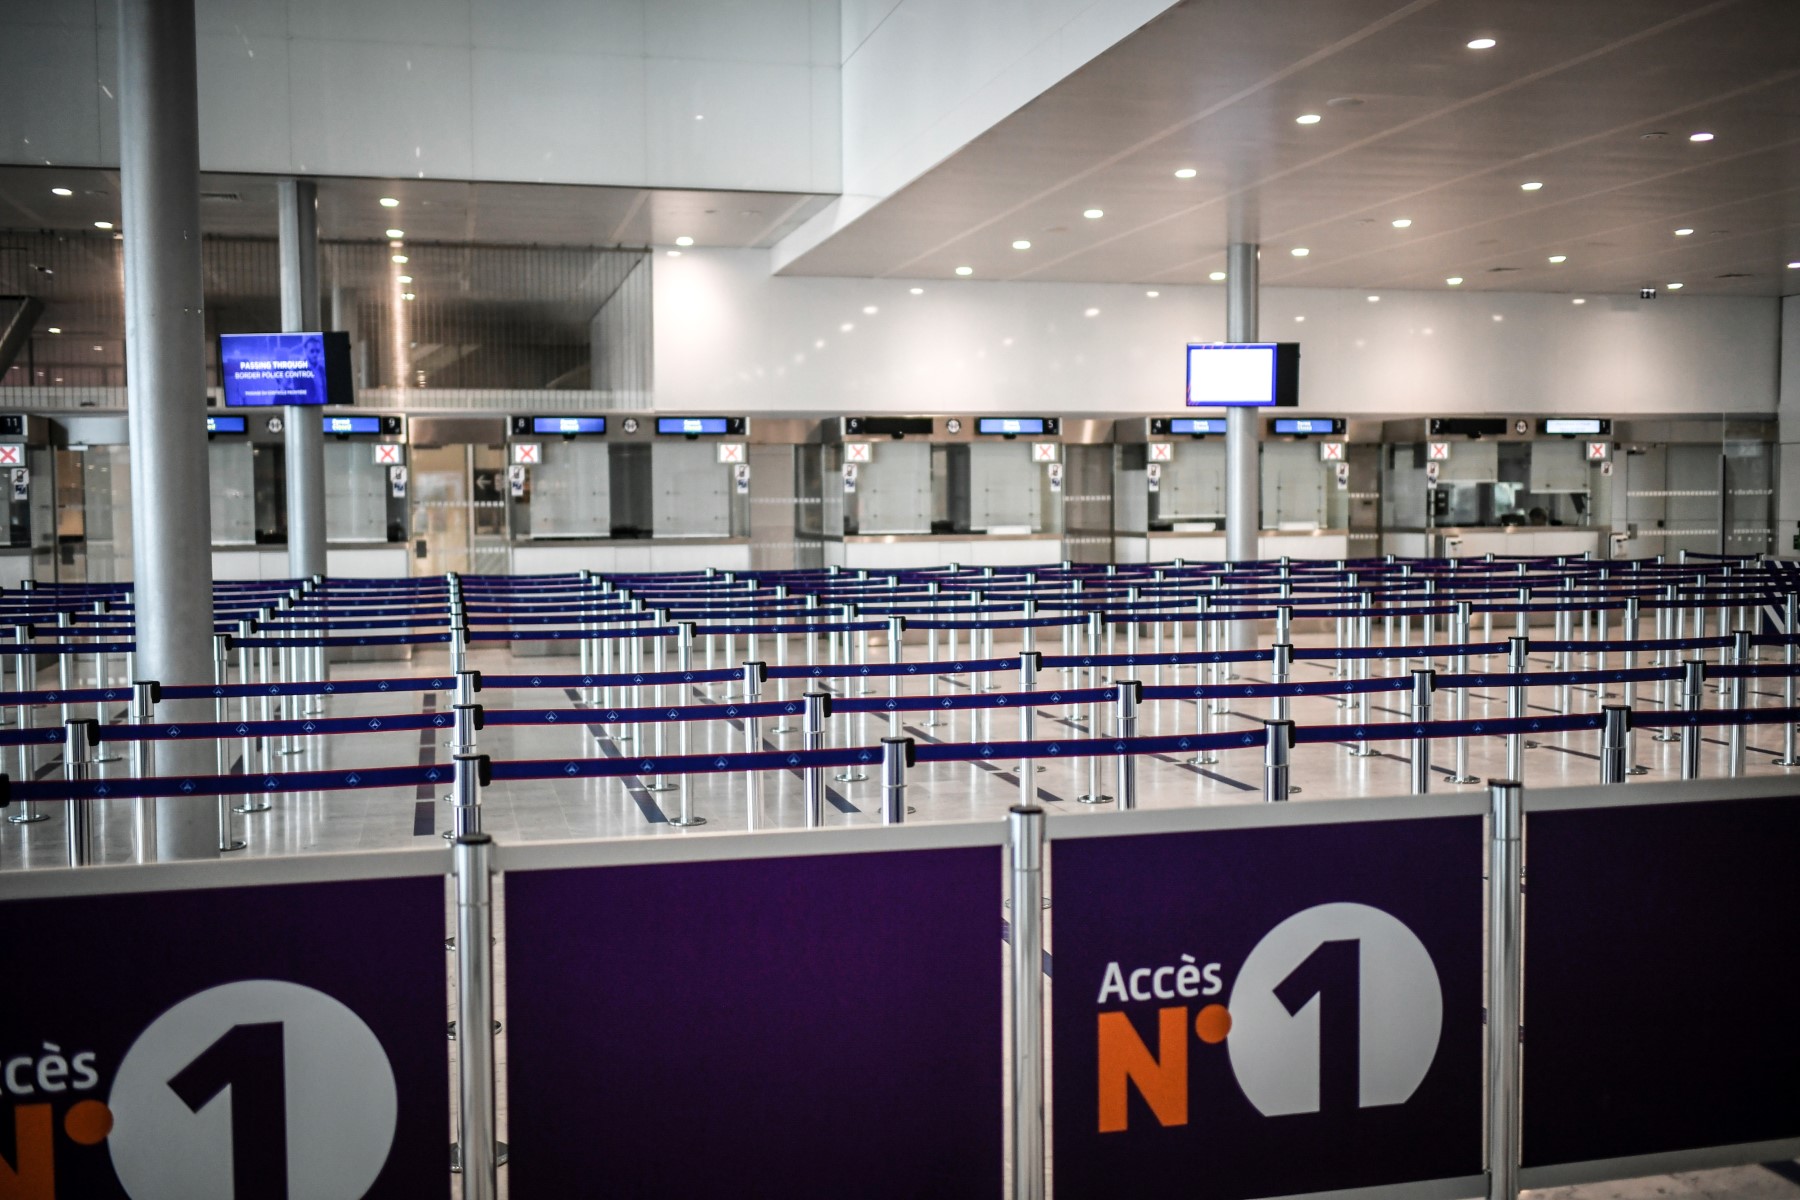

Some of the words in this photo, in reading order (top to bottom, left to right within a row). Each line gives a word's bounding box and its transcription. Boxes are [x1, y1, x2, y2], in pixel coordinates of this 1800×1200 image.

[240, 361, 271, 370] PASSING
[272, 360, 308, 369] THROUGH
[235, 371, 260, 380] BORDER
[262, 371, 284, 379] POLICE
[285, 370, 315, 379] CONTROL
[6, 418, 18, 427] 11
[1097, 954, 1223, 1004] Accès
[0, 1041, 99, 1095] cès
